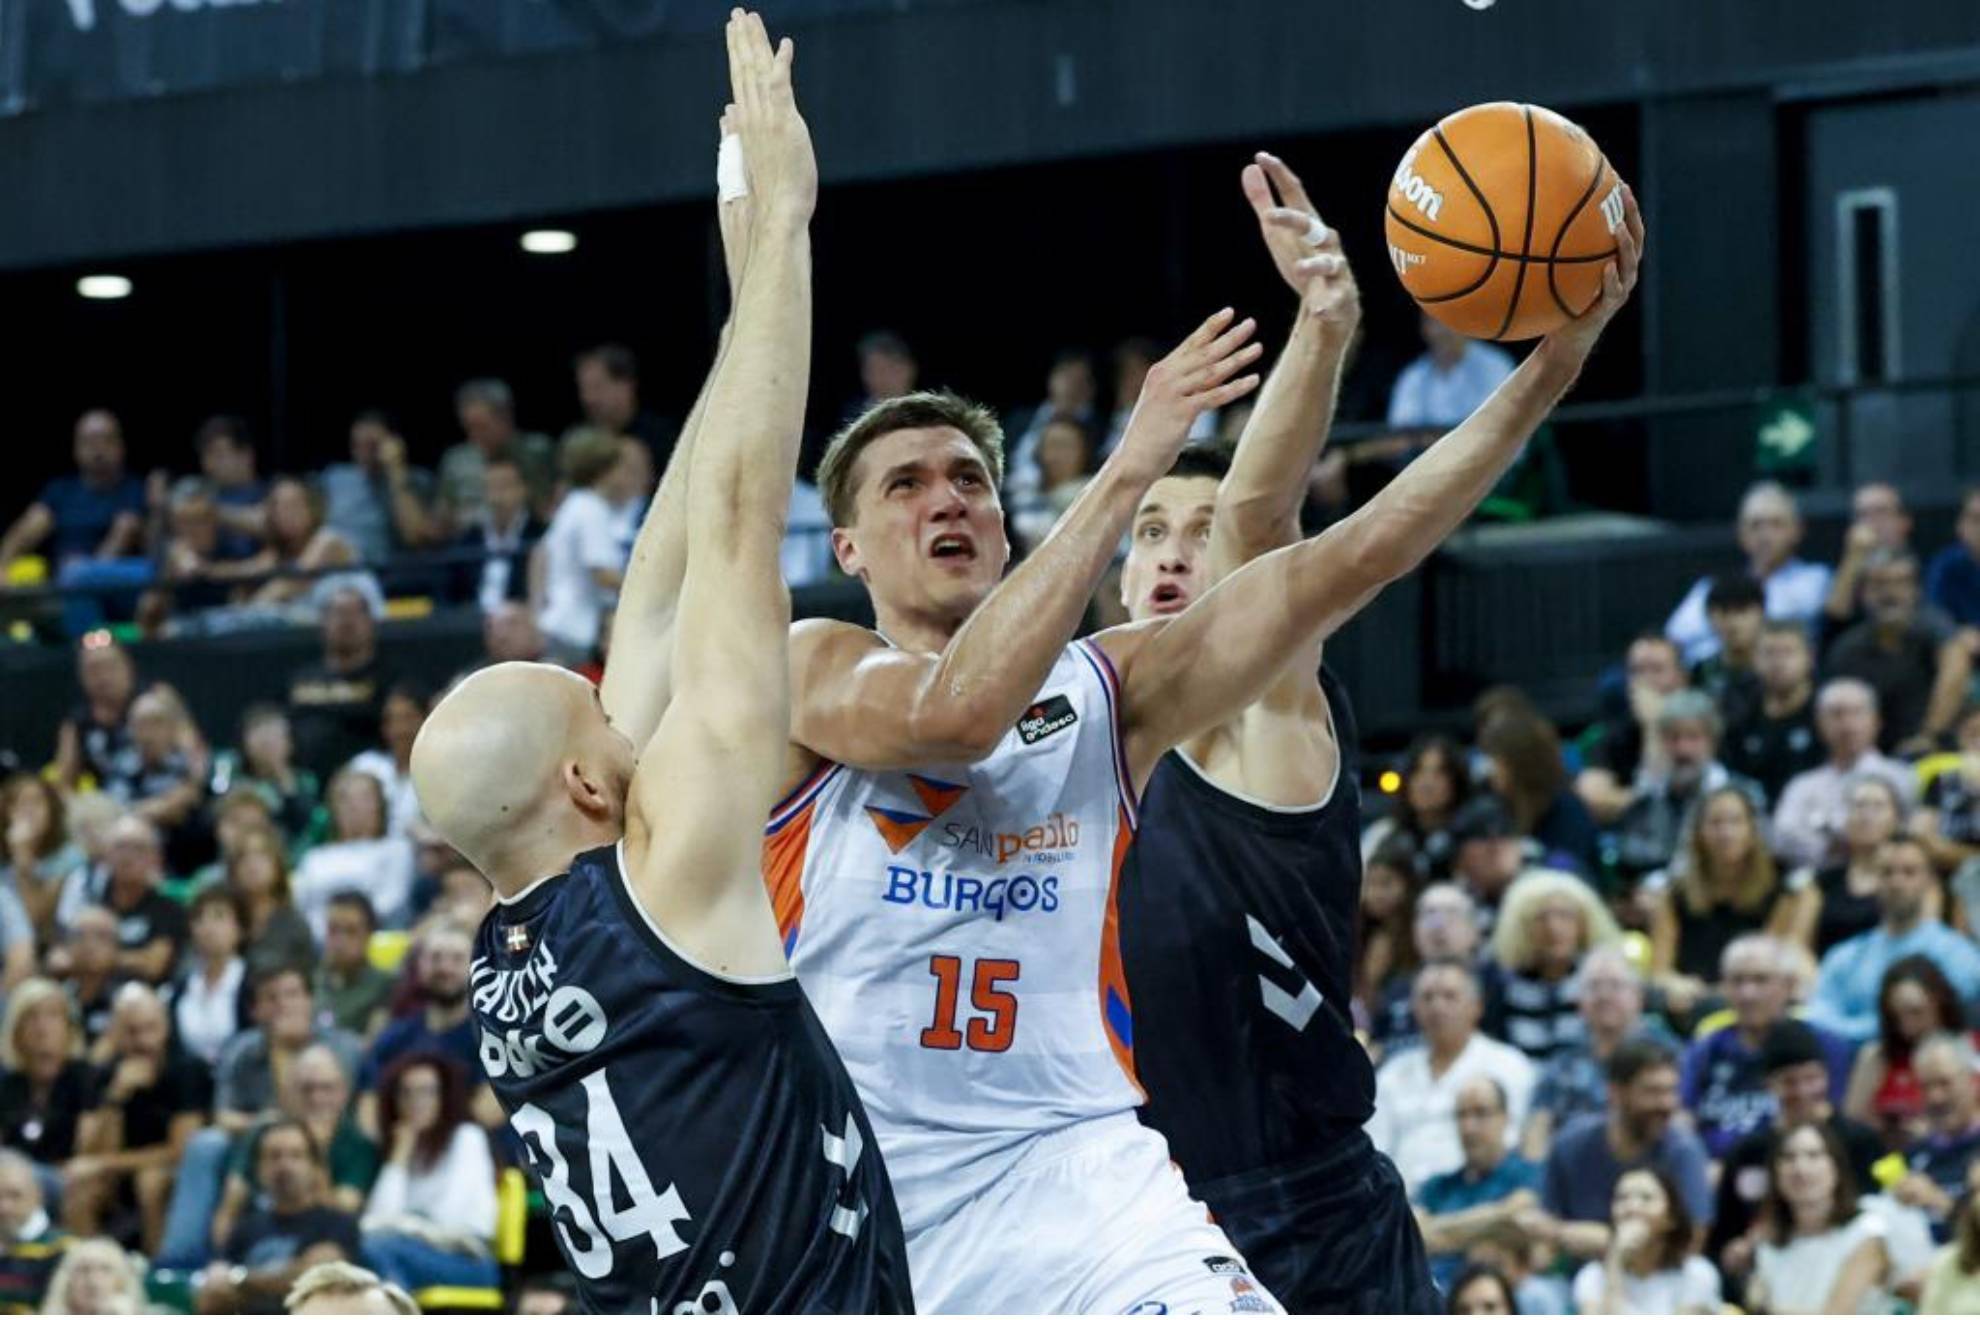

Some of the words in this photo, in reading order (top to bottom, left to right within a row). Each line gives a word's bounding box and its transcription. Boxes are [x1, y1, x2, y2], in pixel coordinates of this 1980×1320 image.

[882, 866, 1059, 922] BURGOS
[920, 954, 1020, 1053] 15
[510, 1067, 693, 1279] 34
